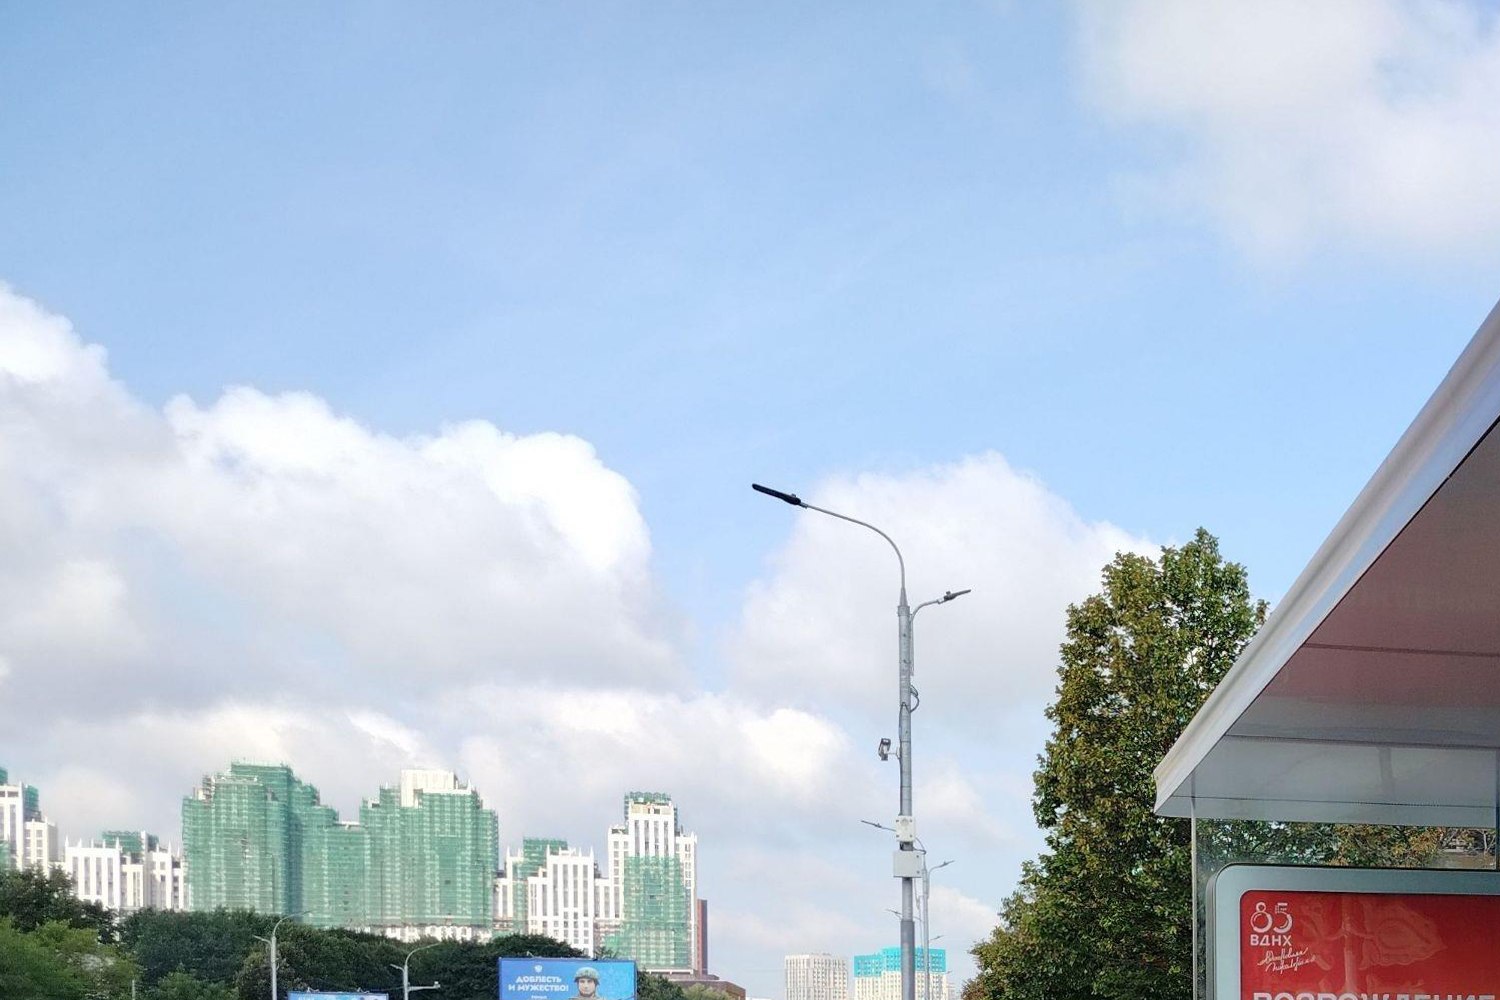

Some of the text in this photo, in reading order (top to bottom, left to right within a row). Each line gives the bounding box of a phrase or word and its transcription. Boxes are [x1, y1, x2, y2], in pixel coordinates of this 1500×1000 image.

[1250, 901, 1293, 934] 85
[1250, 934, 1293, 947] ВДНХ
[515, 975, 562, 984] ДОБЛЕСТЬ
[508, 984, 516, 992] И
